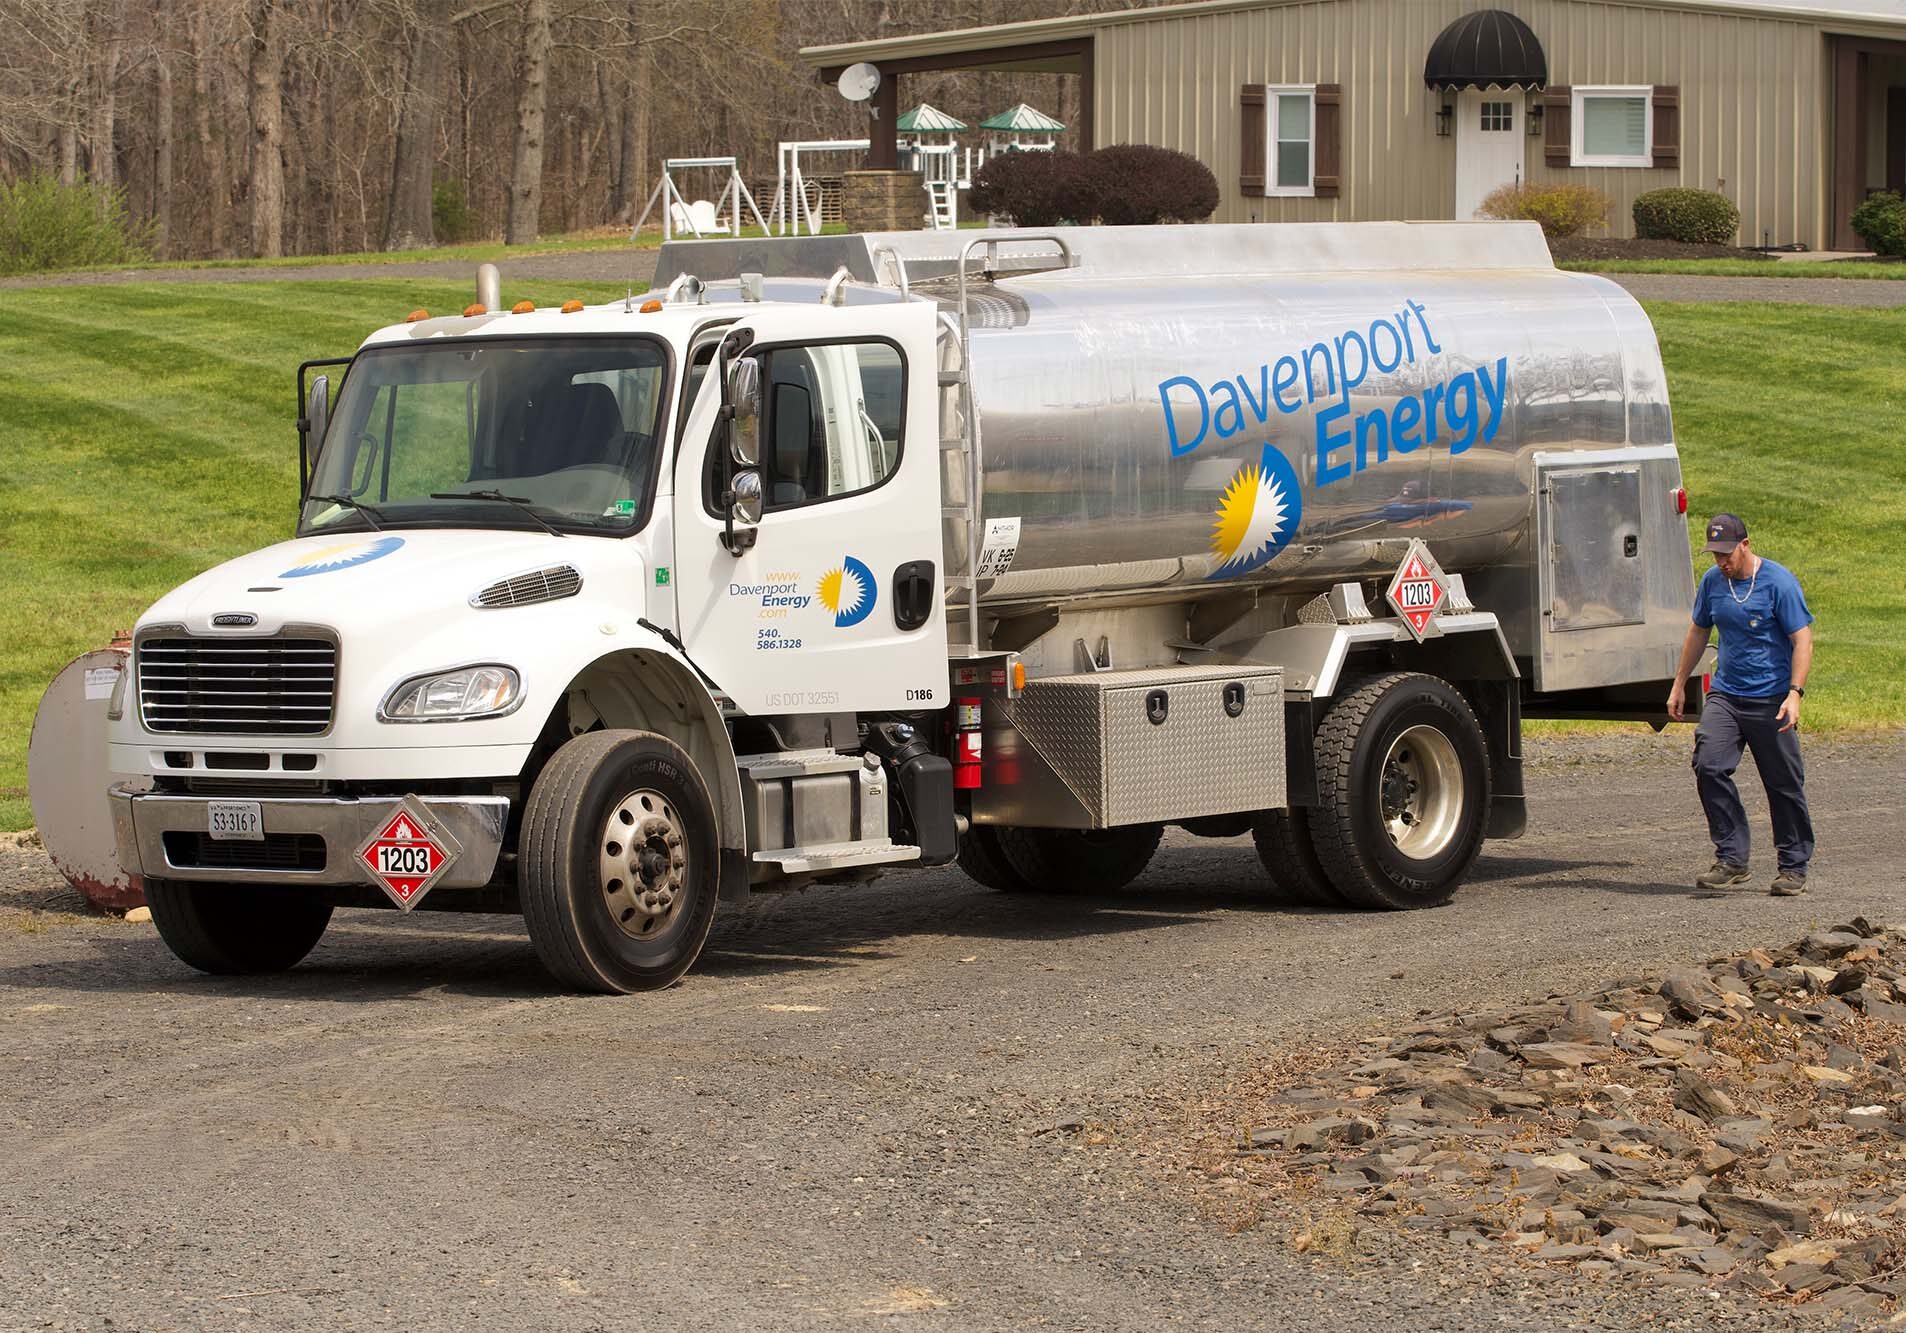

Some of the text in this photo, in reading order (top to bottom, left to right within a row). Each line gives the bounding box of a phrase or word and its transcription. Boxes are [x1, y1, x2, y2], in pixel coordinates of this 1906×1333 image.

[1158, 299, 1442, 458] Davenport
[1315, 356, 1507, 488] Energy
[766, 571, 801, 582] www.
[730, 582, 797, 597] Davenport
[1404, 583, 1431, 606] 1203
[762, 594, 811, 608] Energy
[758, 608, 787, 619] .com
[1416, 614, 1422, 628] 3
[758, 628, 781, 639] 540.
[757, 639, 802, 650] 586.1328
[766, 692, 839, 706] US DOT 32551
[906, 689, 933, 701] D186
[658, 761, 678, 780] HSR
[380, 847, 429, 873] 1203
[401, 884, 410, 897] 3
